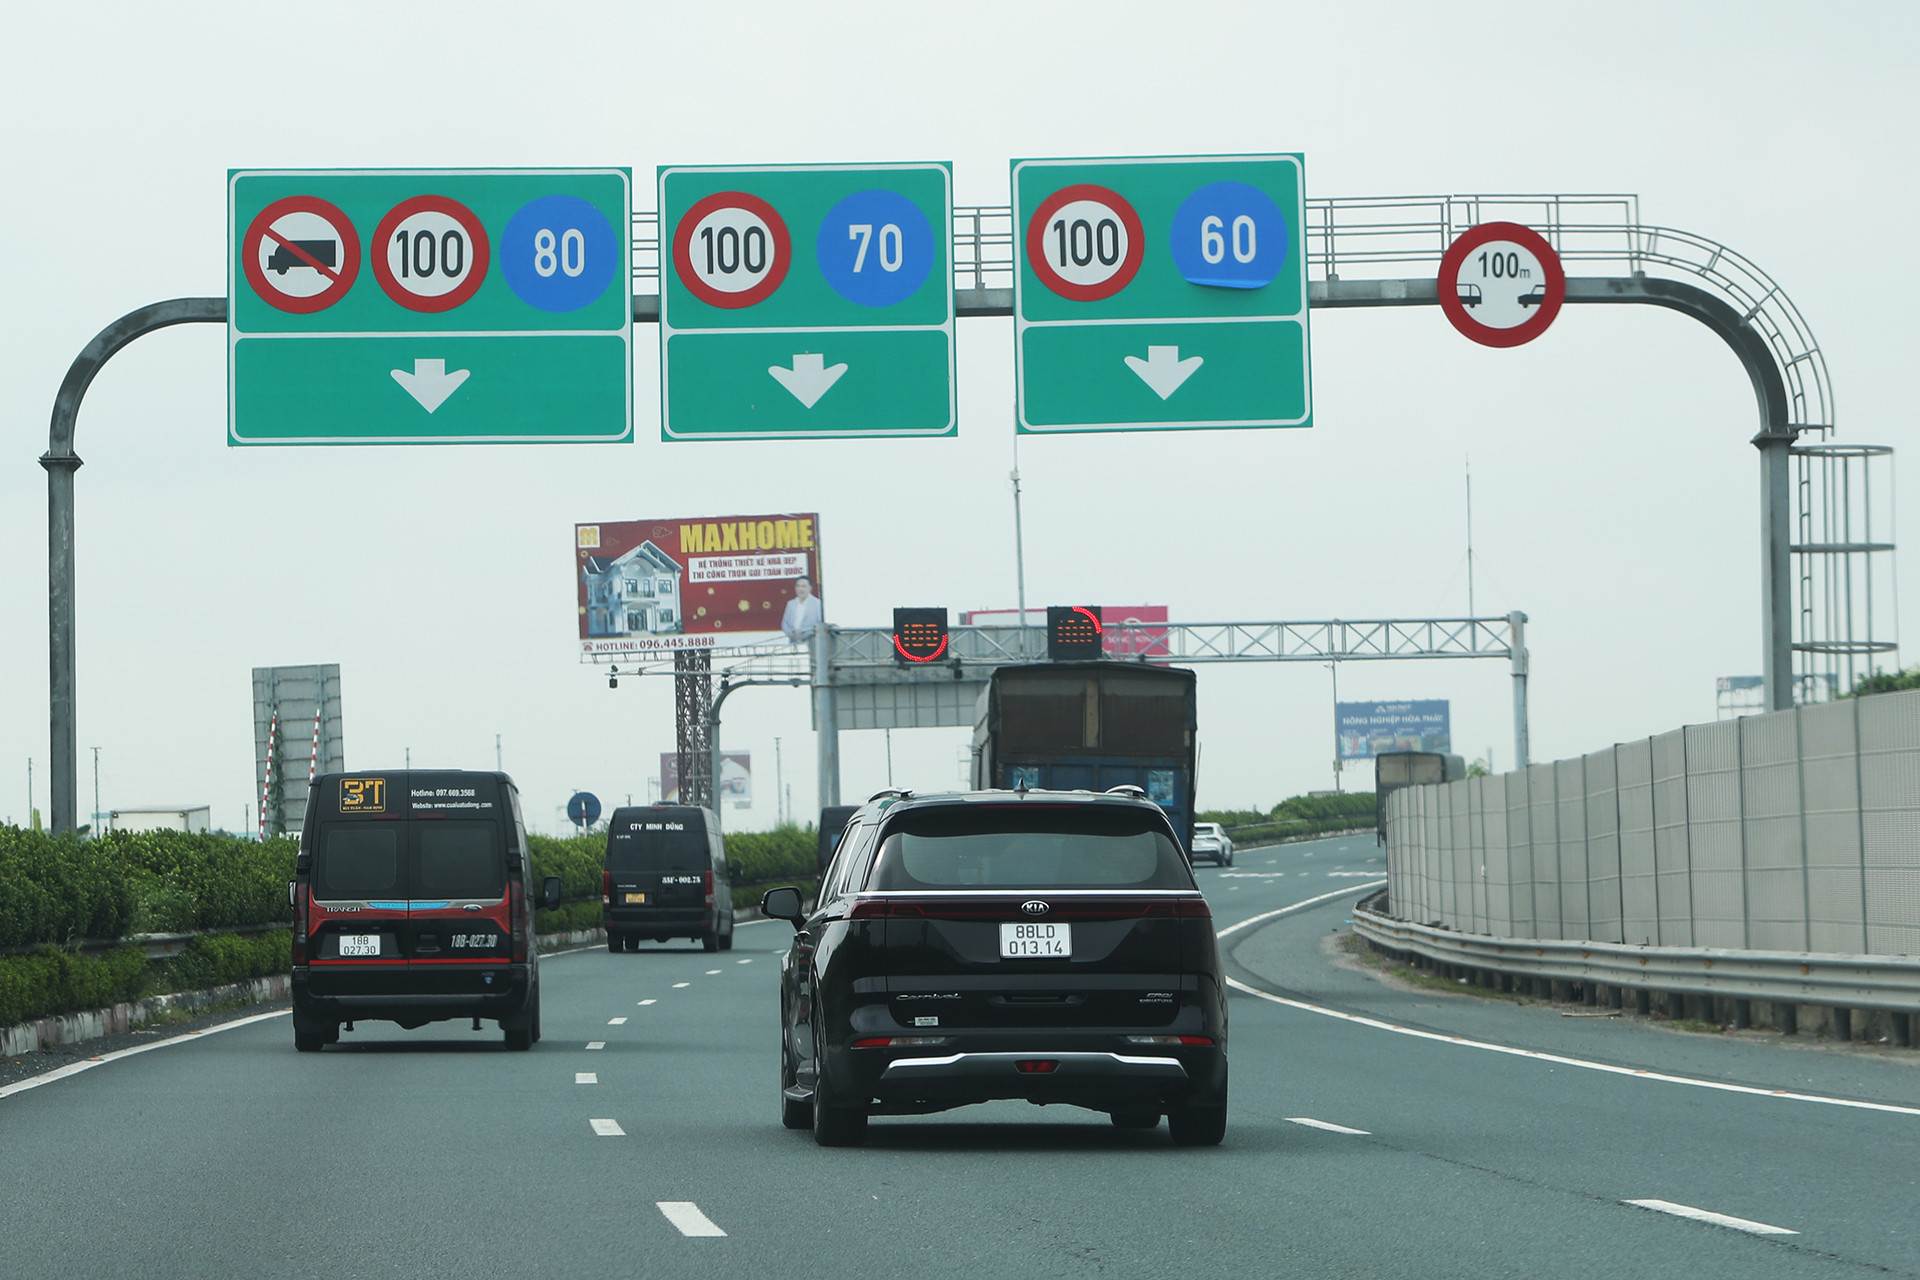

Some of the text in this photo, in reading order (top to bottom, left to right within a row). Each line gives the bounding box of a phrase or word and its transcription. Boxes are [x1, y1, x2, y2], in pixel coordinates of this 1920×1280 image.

[1053, 218, 1119, 267] 100
[1201, 214, 1257, 264] 60
[396, 230, 463, 278] 100
[534, 228, 585, 277] 80
[700, 226, 766, 274] 100
[849, 224, 904, 273] 70
[680, 519, 814, 553] MAXHOME
[693, 571, 704, 579] THI
[596, 636, 715, 651] HOTLINE: 096.445.8888
[411, 789, 434, 797] Hotline:
[1026, 903, 1045, 912] KIA
[1016, 924, 1056, 939] 88LD
[352, 936, 369, 945] 18B
[1009, 940, 1063, 955] 013.14
[343, 945, 376, 955] 027.30
